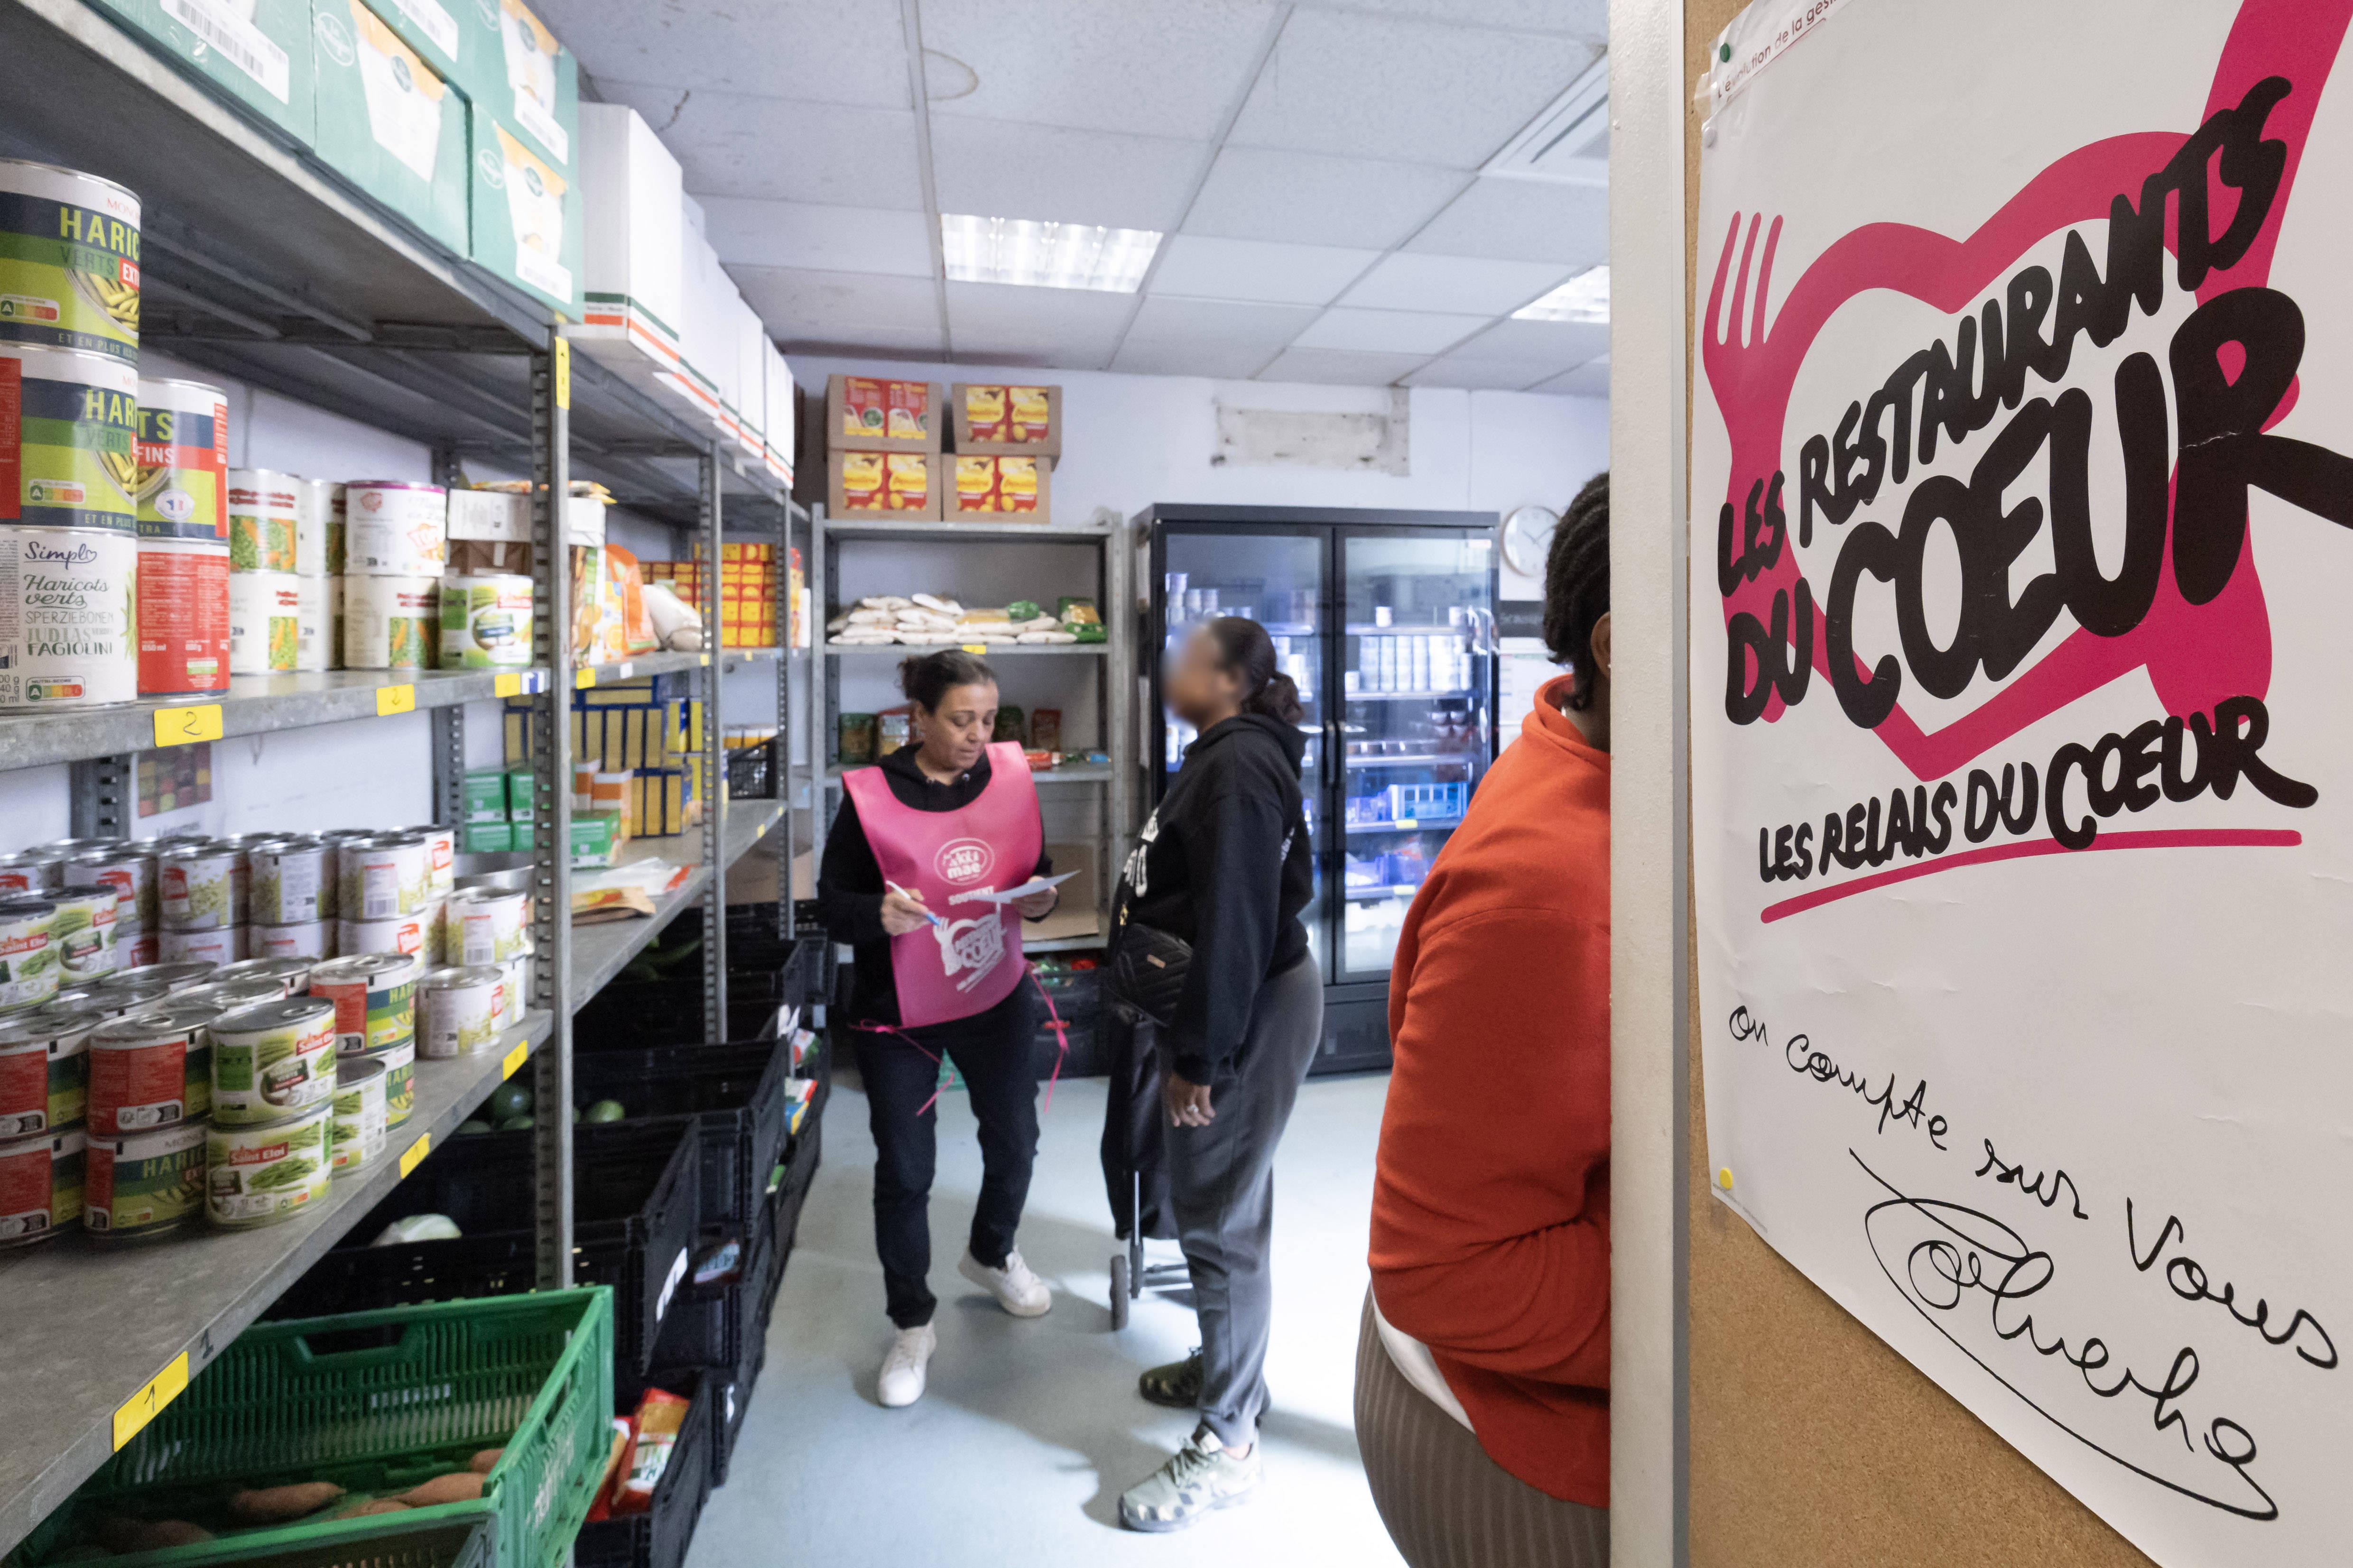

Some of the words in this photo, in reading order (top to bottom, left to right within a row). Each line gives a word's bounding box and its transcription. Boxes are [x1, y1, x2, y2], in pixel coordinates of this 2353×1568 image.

[1775, 32, 1788, 49] de
[1792, 20, 1802, 35] la
[1806, 0, 1834, 25] ges
[60, 245, 114, 275] VERTS
[58, 333, 71, 343] ET
[78, 337, 92, 347] EN
[1718, 470, 1786, 597] LES
[1799, 76, 2292, 548] RESTAURANTS
[24, 574, 109, 592] Haricots
[25, 592, 87, 609] verts
[27, 627, 91, 643] JUDIAS
[28, 642, 112, 656] FAGIOLINI
[1725, 578, 1813, 725] DU
[13, 676, 19, 685] g
[183, 711, 203, 736] 2
[1760, 822, 1814, 883] LES
[1819, 782, 1957, 876] RELAIS
[1964, 762, 2038, 843] DU
[1975, 1138, 2088, 1219] sur
[144, 1384, 155, 1412] 1
